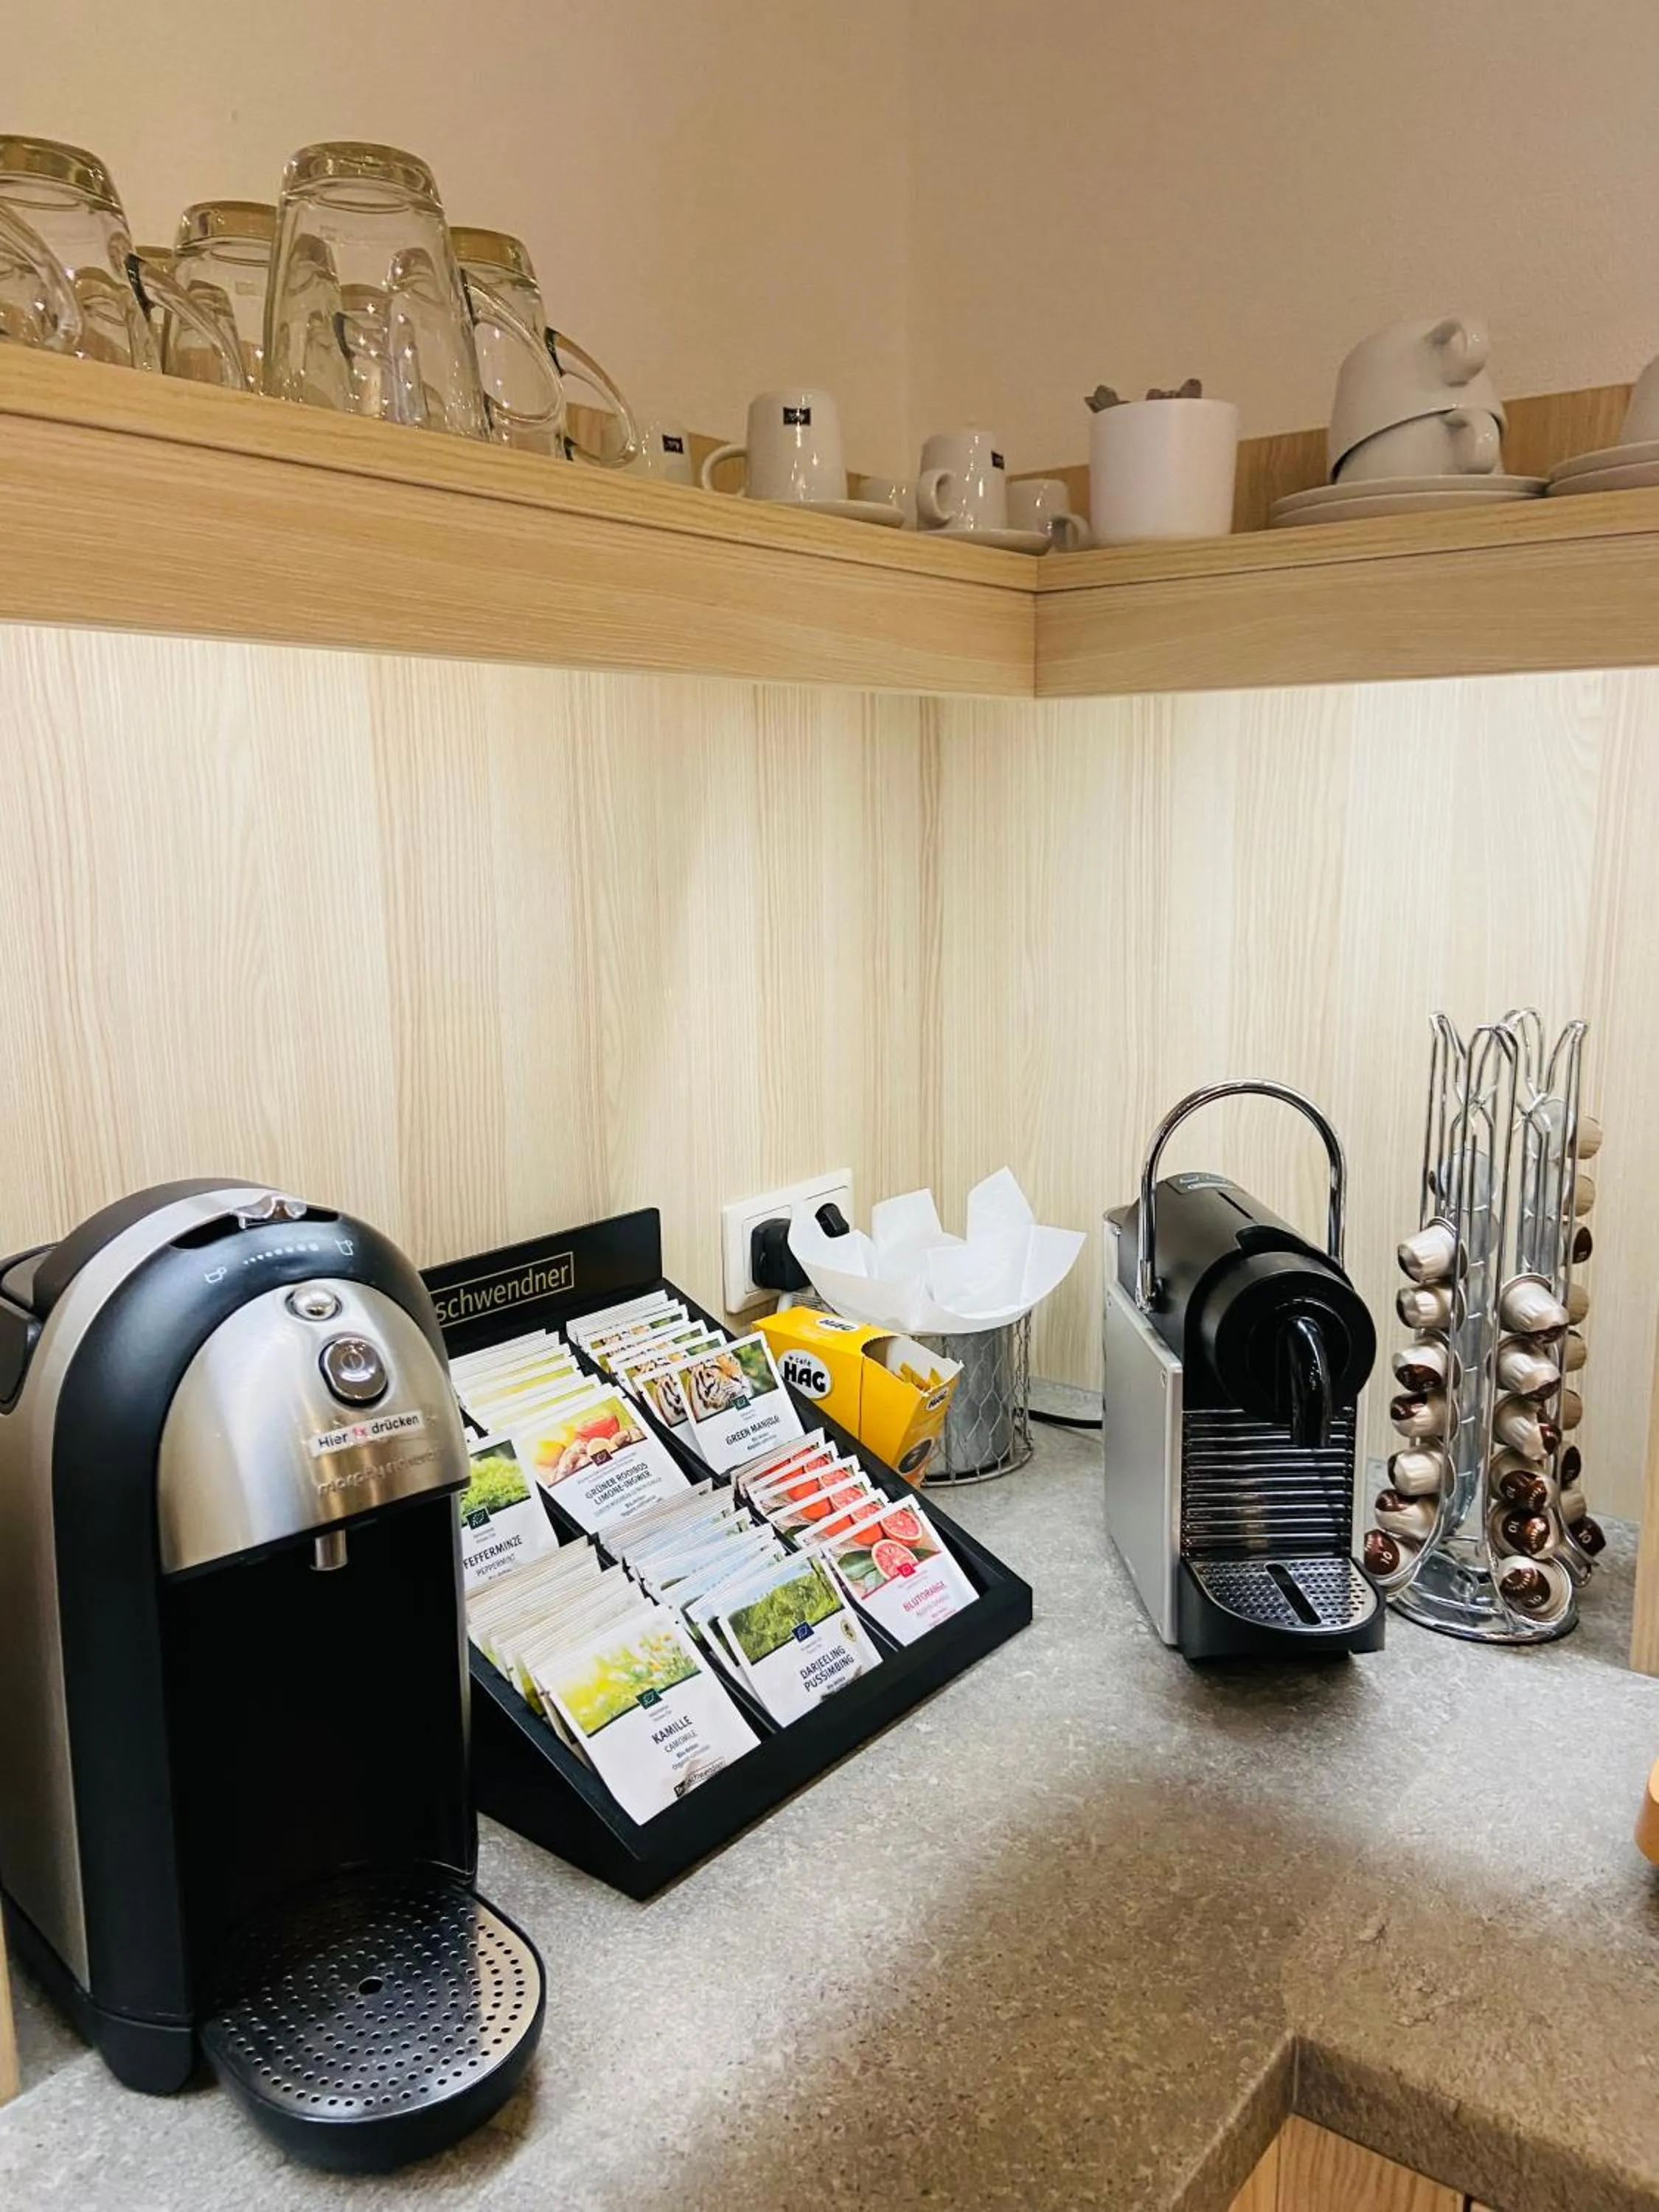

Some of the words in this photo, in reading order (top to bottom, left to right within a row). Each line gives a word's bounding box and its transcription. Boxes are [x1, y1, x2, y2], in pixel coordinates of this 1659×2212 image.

[435, 1265, 569, 1323] schwendner
[784, 1360, 826, 1393] HAG
[319, 1432, 349, 1448] Hier
[371, 1414, 420, 1436] drücken
[725, 1427, 751, 1446] GREEN
[462, 1534, 523, 1570] FEFFERMINZE
[1380, 1551, 1393, 1564] 10
[799, 1645, 846, 1680] DARJEELING
[803, 1654, 855, 1692] PUSSIMBING
[651, 1714, 694, 1745] KAMILLE
